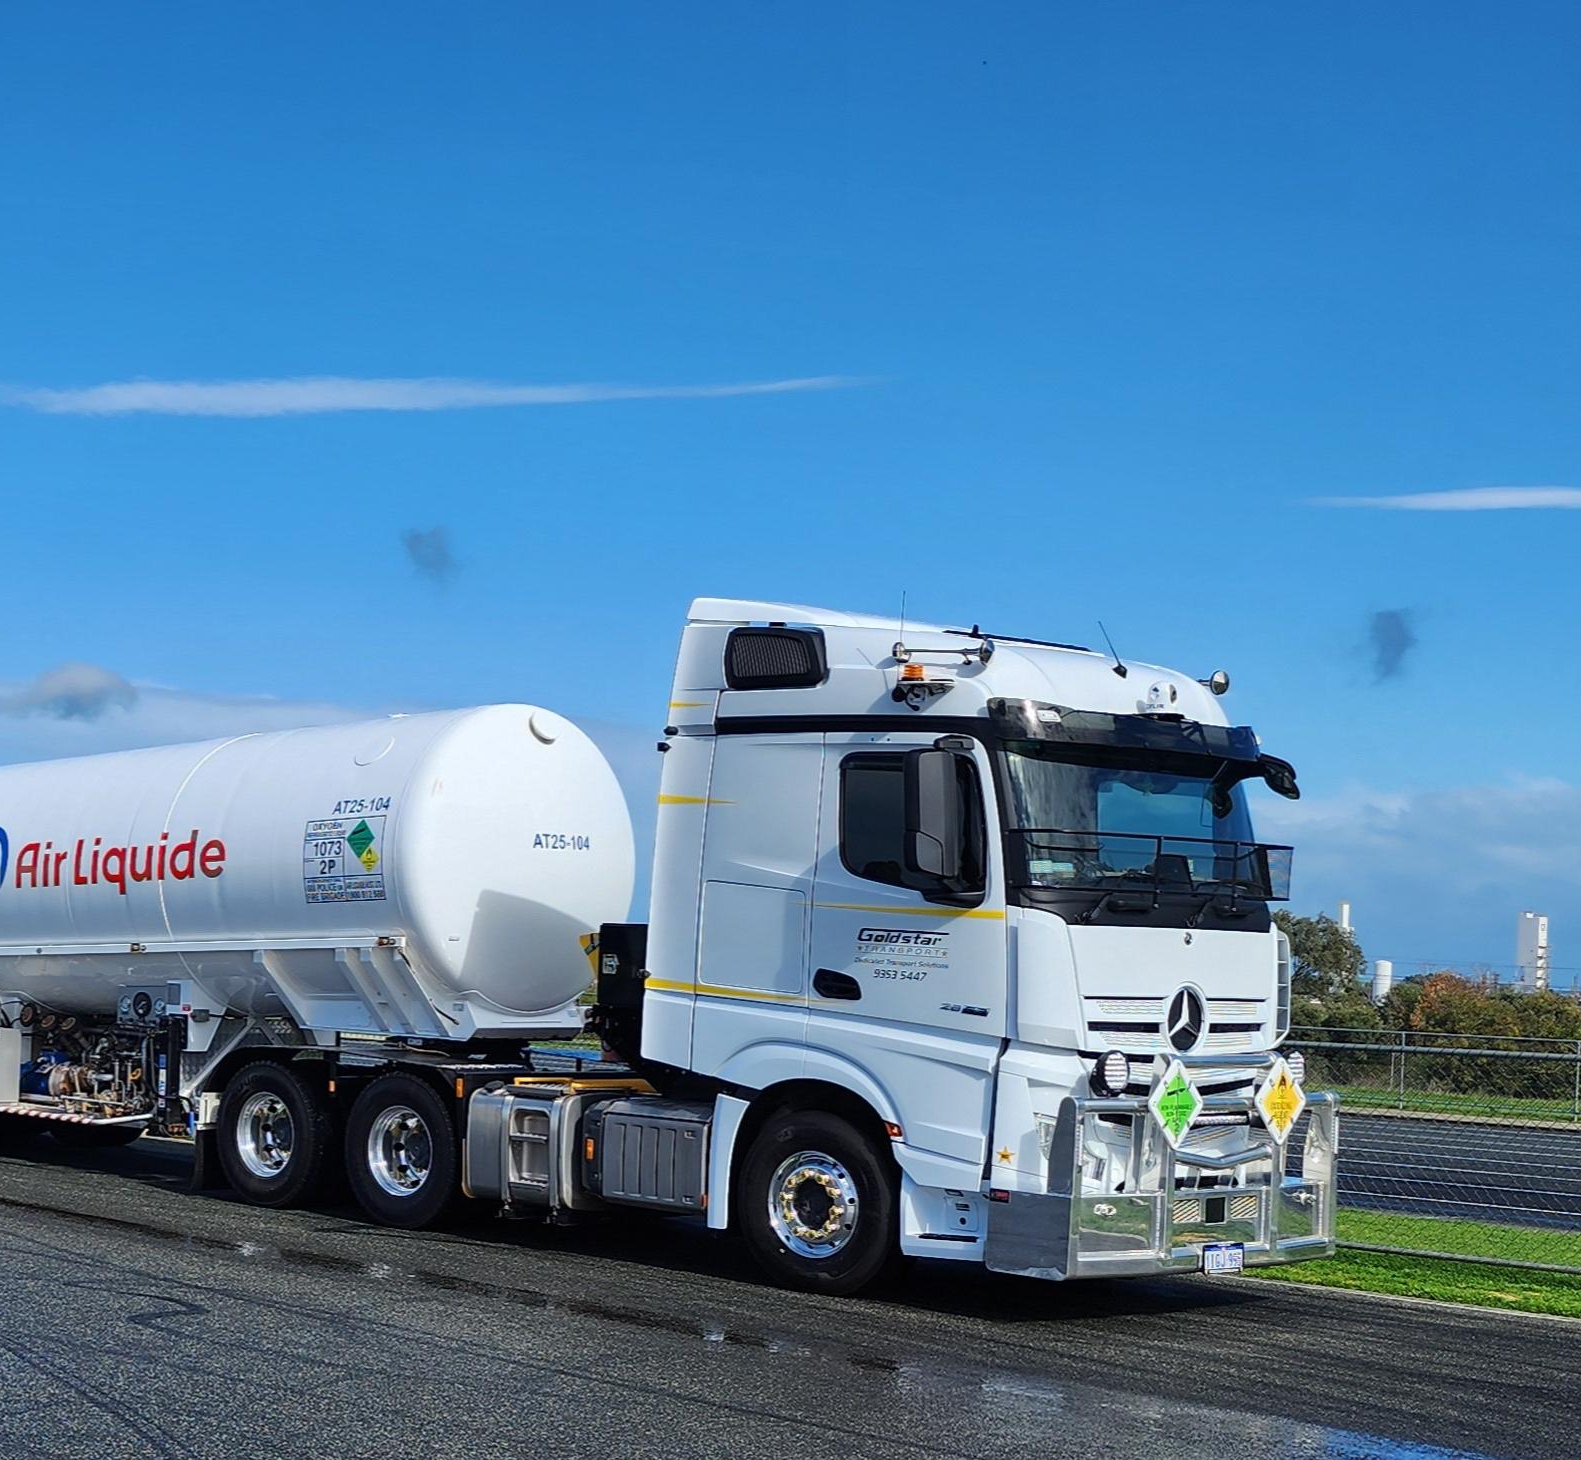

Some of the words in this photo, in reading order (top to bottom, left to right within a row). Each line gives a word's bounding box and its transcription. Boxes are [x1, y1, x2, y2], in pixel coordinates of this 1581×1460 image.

[332, 797, 391, 815] AT25-104
[313, 841, 342, 856] 1073
[533, 833, 590, 850] AT25-104
[15, 841, 68, 888] Air
[73, 829, 226, 895] Liquide
[320, 859, 336, 874] 2P
[857, 928, 950, 945] Goldstar
[863, 945, 940, 956] TRANSPORT
[885, 958, 917, 968] Transport
[900, 971, 927, 981] 5447
